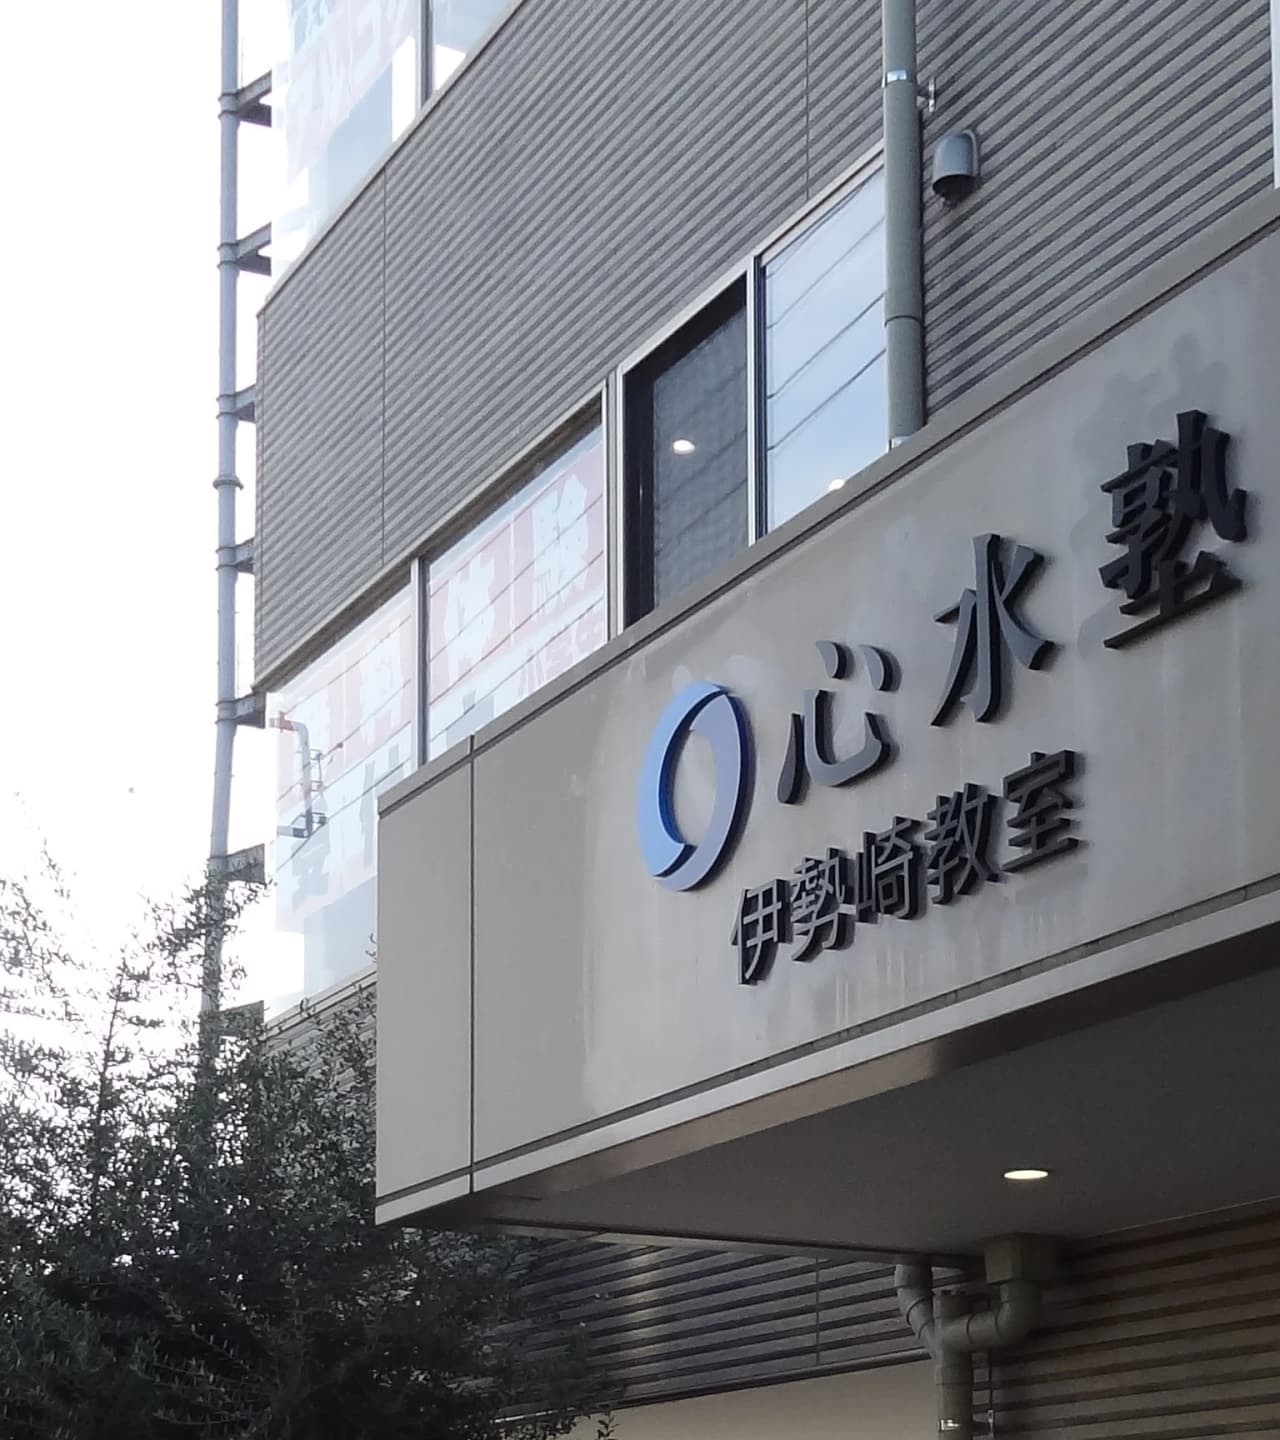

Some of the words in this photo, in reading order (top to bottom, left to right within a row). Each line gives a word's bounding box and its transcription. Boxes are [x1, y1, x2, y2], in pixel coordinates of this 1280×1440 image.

[777, 409, 1248, 805] 心水塾
[731, 749, 1086, 985] 伊勢崎教室
